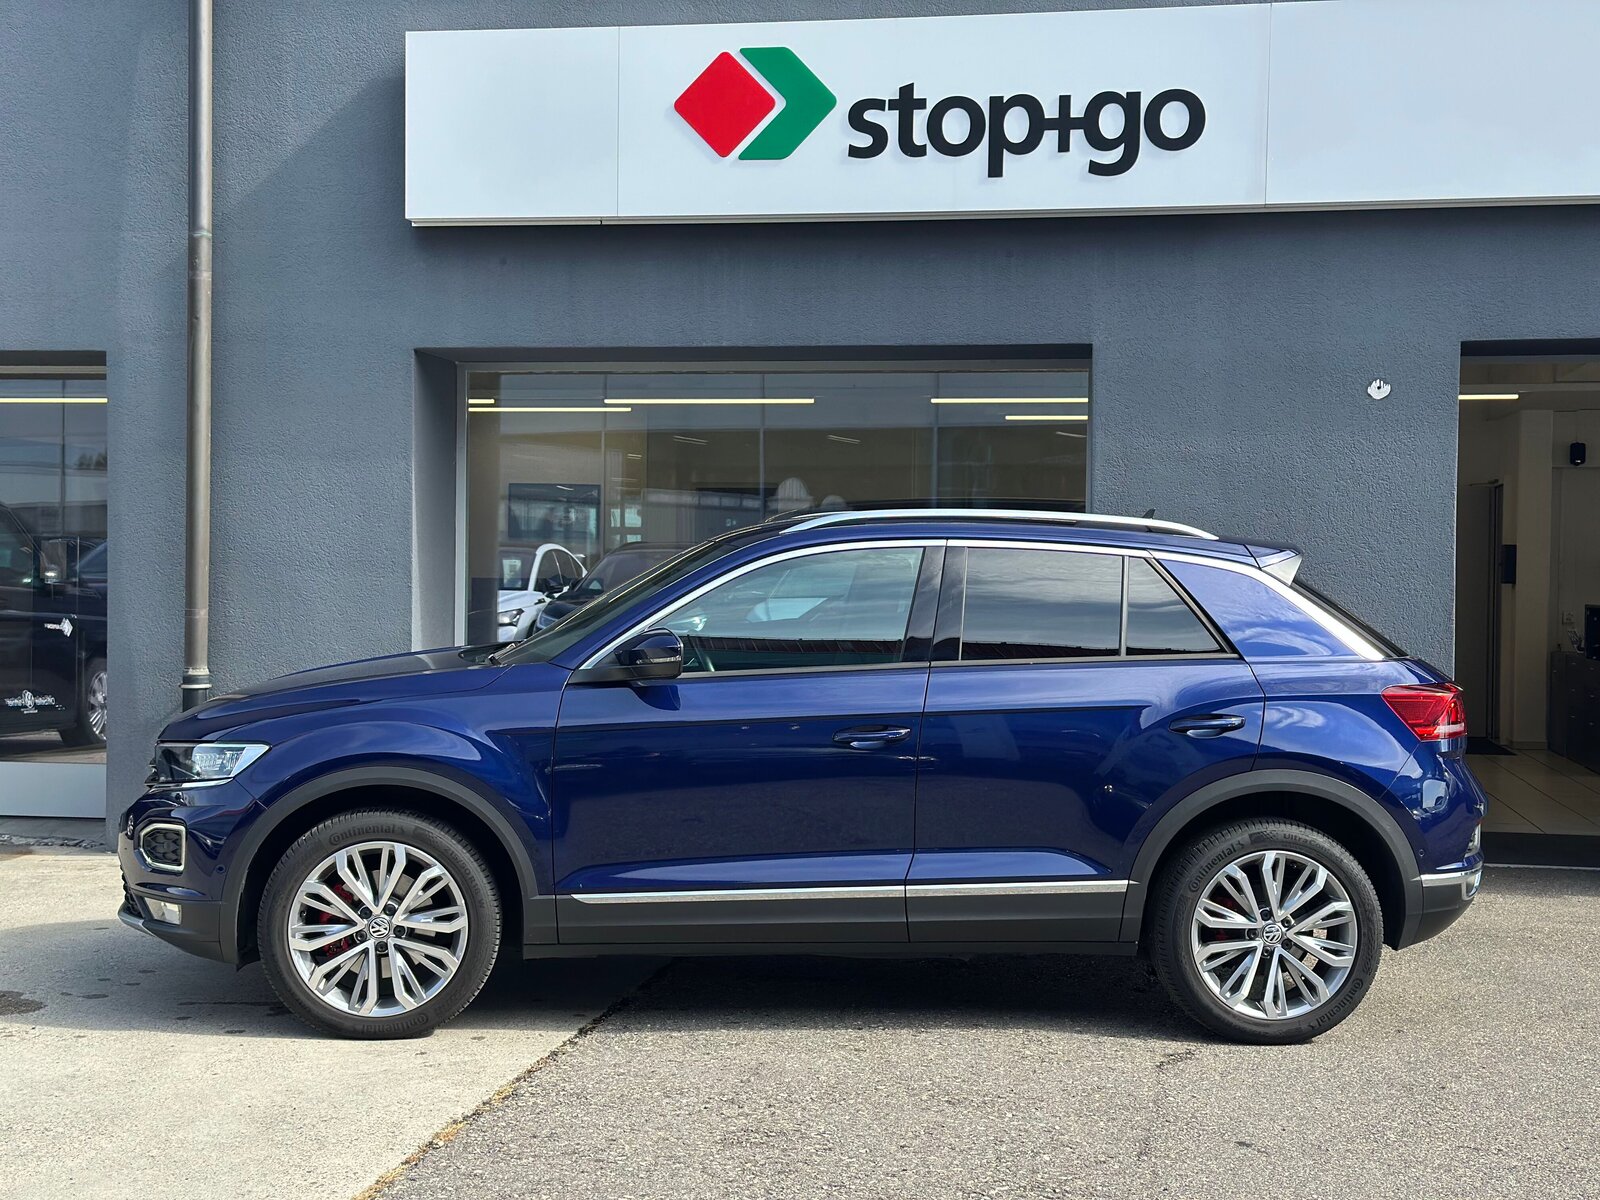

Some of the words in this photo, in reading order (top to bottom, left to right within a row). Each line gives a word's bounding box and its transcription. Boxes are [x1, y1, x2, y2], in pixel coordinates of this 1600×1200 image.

[847, 82, 1206, 178] stop+go
[328, 824, 395, 846] Continental
[1188, 844, 1237, 893] Continental
[360, 1012, 430, 1034] Continental
[1315, 977, 1364, 1028] Continental
